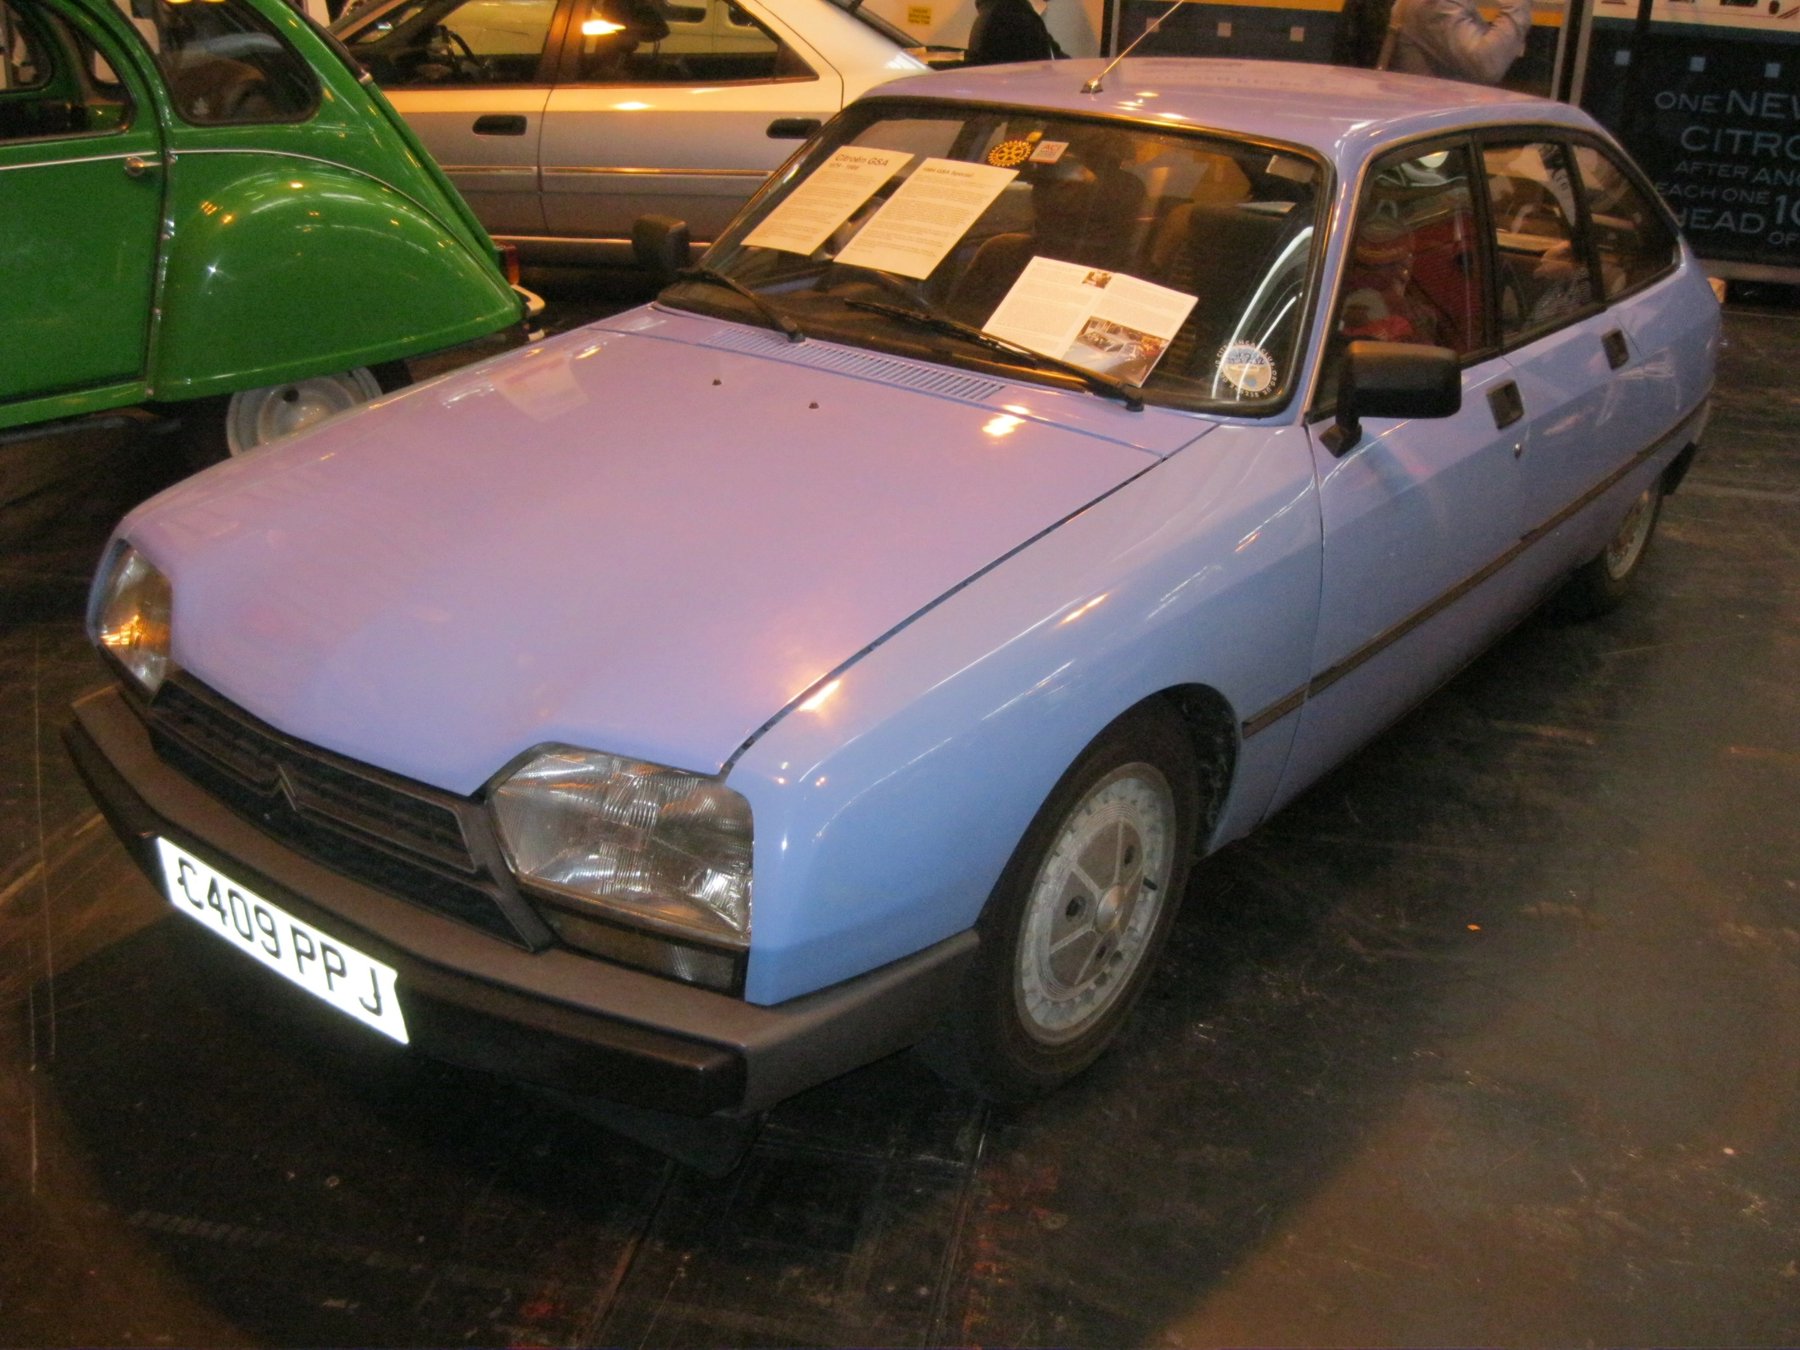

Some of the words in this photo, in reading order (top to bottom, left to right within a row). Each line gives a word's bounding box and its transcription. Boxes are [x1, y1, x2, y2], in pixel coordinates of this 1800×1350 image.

[1655, 90, 1723, 113] ONE
[1674, 160, 1749, 179] AFTER
[1751, 167, 1800, 187] AN
[1721, 187, 1770, 206] ONE
[177, 857, 282, 960] C409
